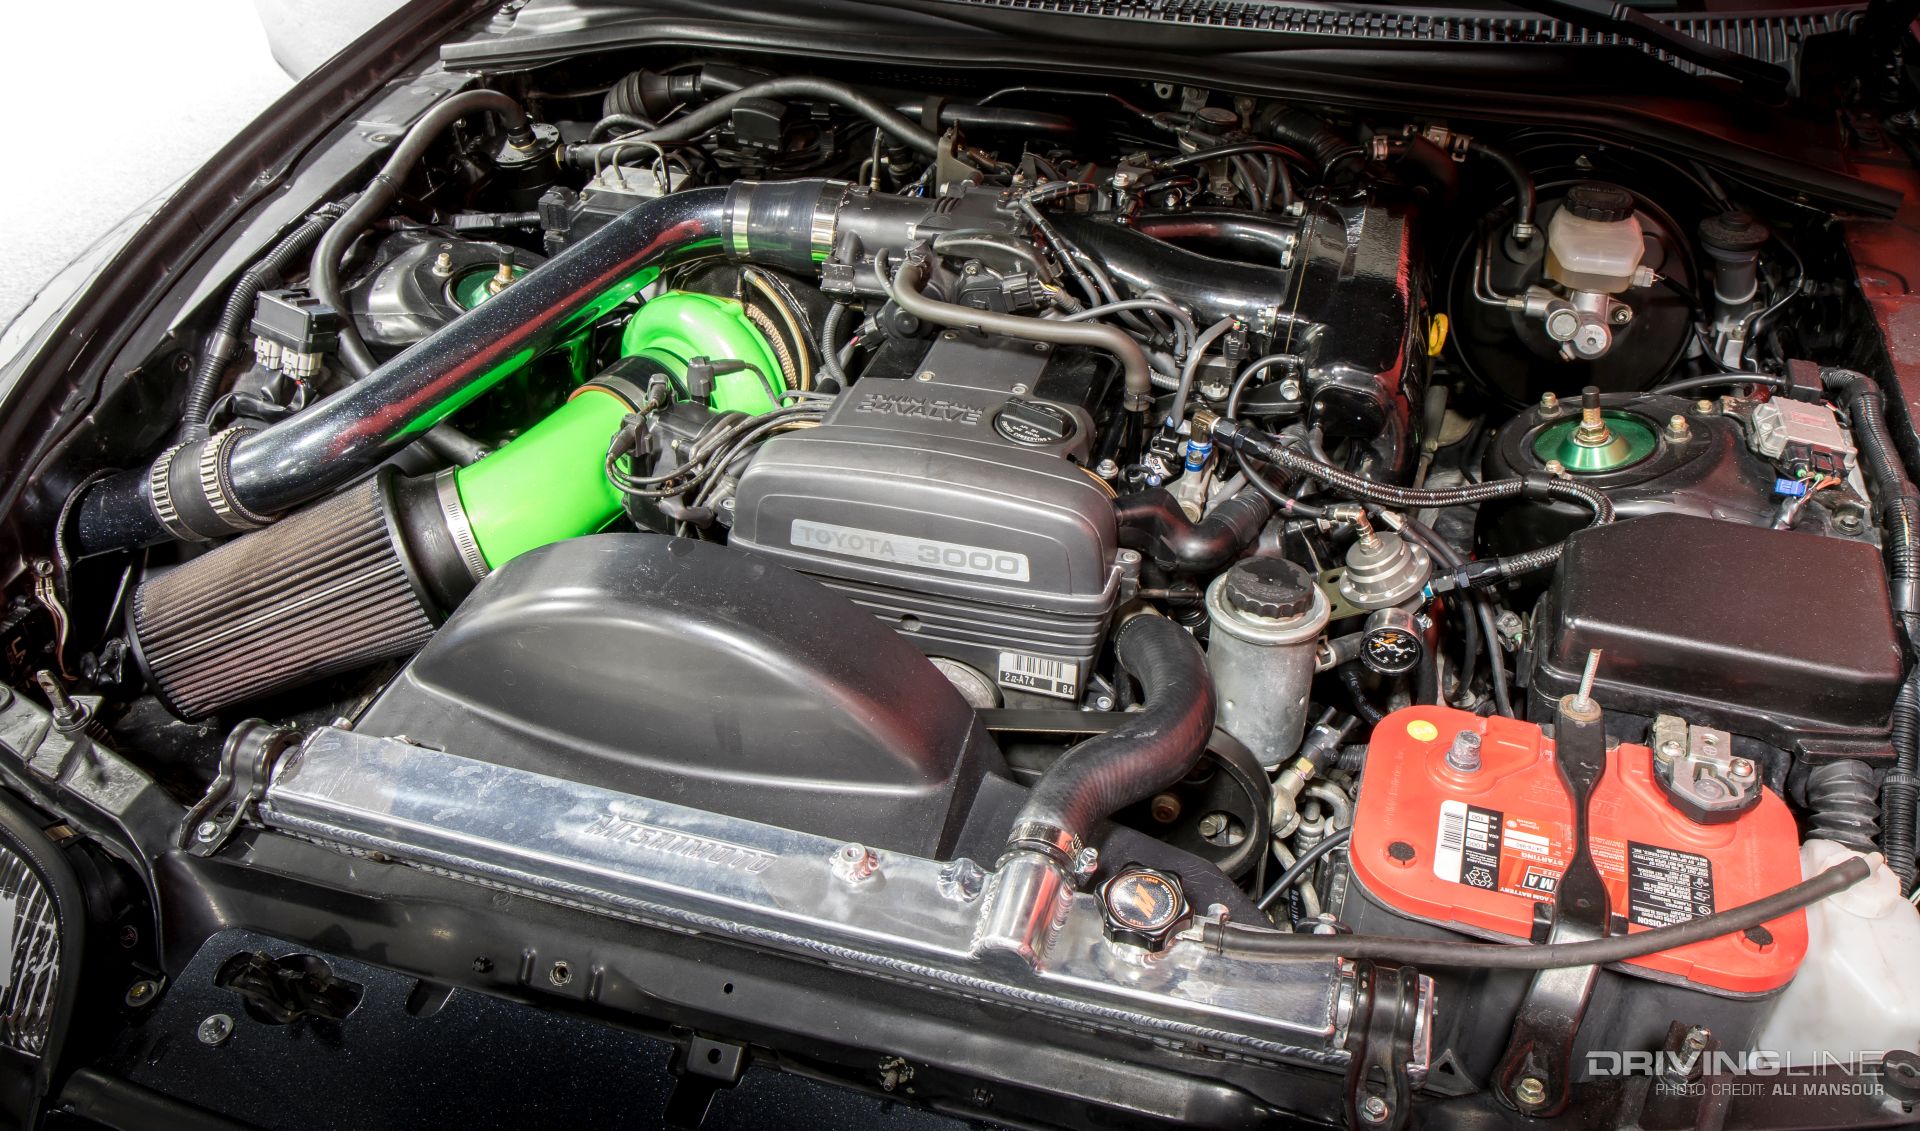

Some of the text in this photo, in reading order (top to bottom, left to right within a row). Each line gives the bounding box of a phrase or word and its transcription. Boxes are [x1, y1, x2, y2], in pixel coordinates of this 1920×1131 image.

[801, 526, 1019, 575] TOYOTA 3000
[1062, 684, 1073, 695] 84
[583, 814, 778, 875] MISHIMOTO
[1521, 852, 1564, 865] STARTING
[1499, 887, 1532, 897] BATTERY
